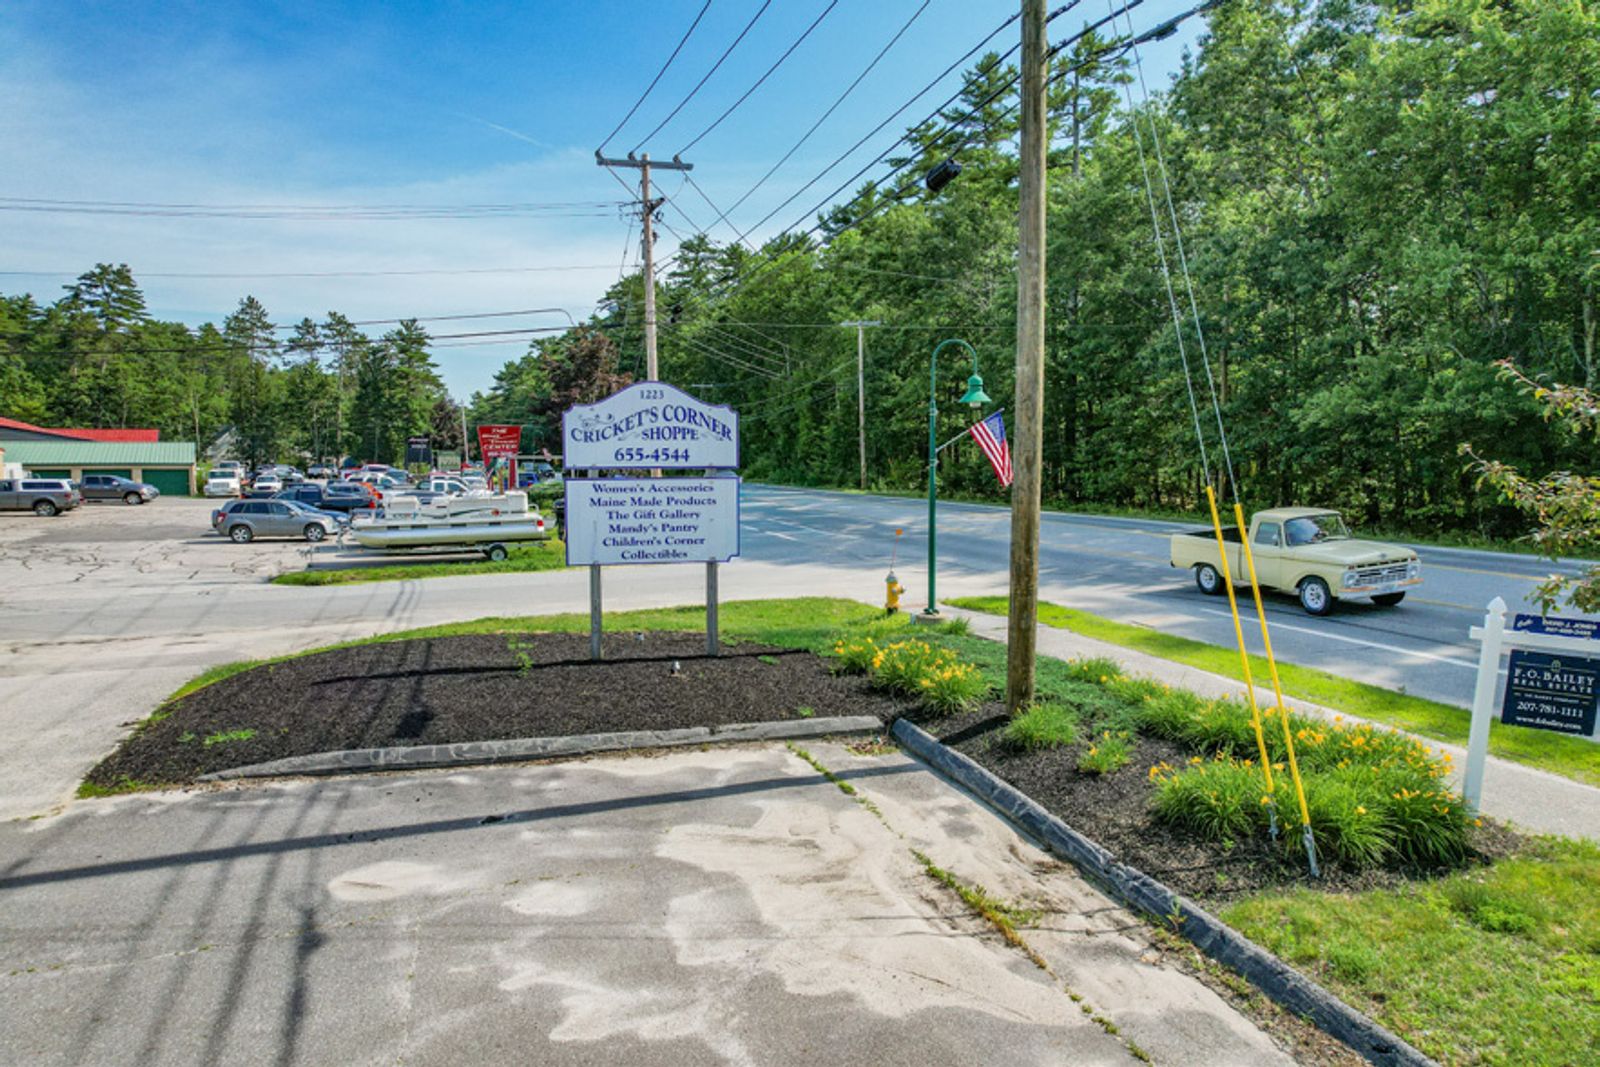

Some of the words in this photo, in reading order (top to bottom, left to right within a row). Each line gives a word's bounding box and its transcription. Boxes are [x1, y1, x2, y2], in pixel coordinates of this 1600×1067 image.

[640, 389, 664, 400] 1223
[570, 405, 659, 443] CRICKET'S
[662, 404, 733, 441] CORNER
[641, 425, 699, 441] SHOPPE
[614, 447, 690, 463] 655-4544
[592, 483, 645, 493] Women's
[648, 483, 714, 493] Accessories
[589, 497, 627, 507] Maine
[630, 496, 663, 507] Made
[666, 496, 717, 506] Products
[606, 510, 630, 520] The
[633, 509, 656, 520] Gift
[659, 509, 701, 520] Gallery
[608, 523, 658, 535] Mandy's
[661, 523, 699, 533] Pantry
[602, 536, 662, 547] Children's
[664, 536, 706, 546] Corner
[621, 549, 688, 560] Collectibles
[1543, 671, 1595, 686] BAILEY
[1513, 678, 1542, 688] REAL
[1548, 681, 1593, 694] ESTATE
